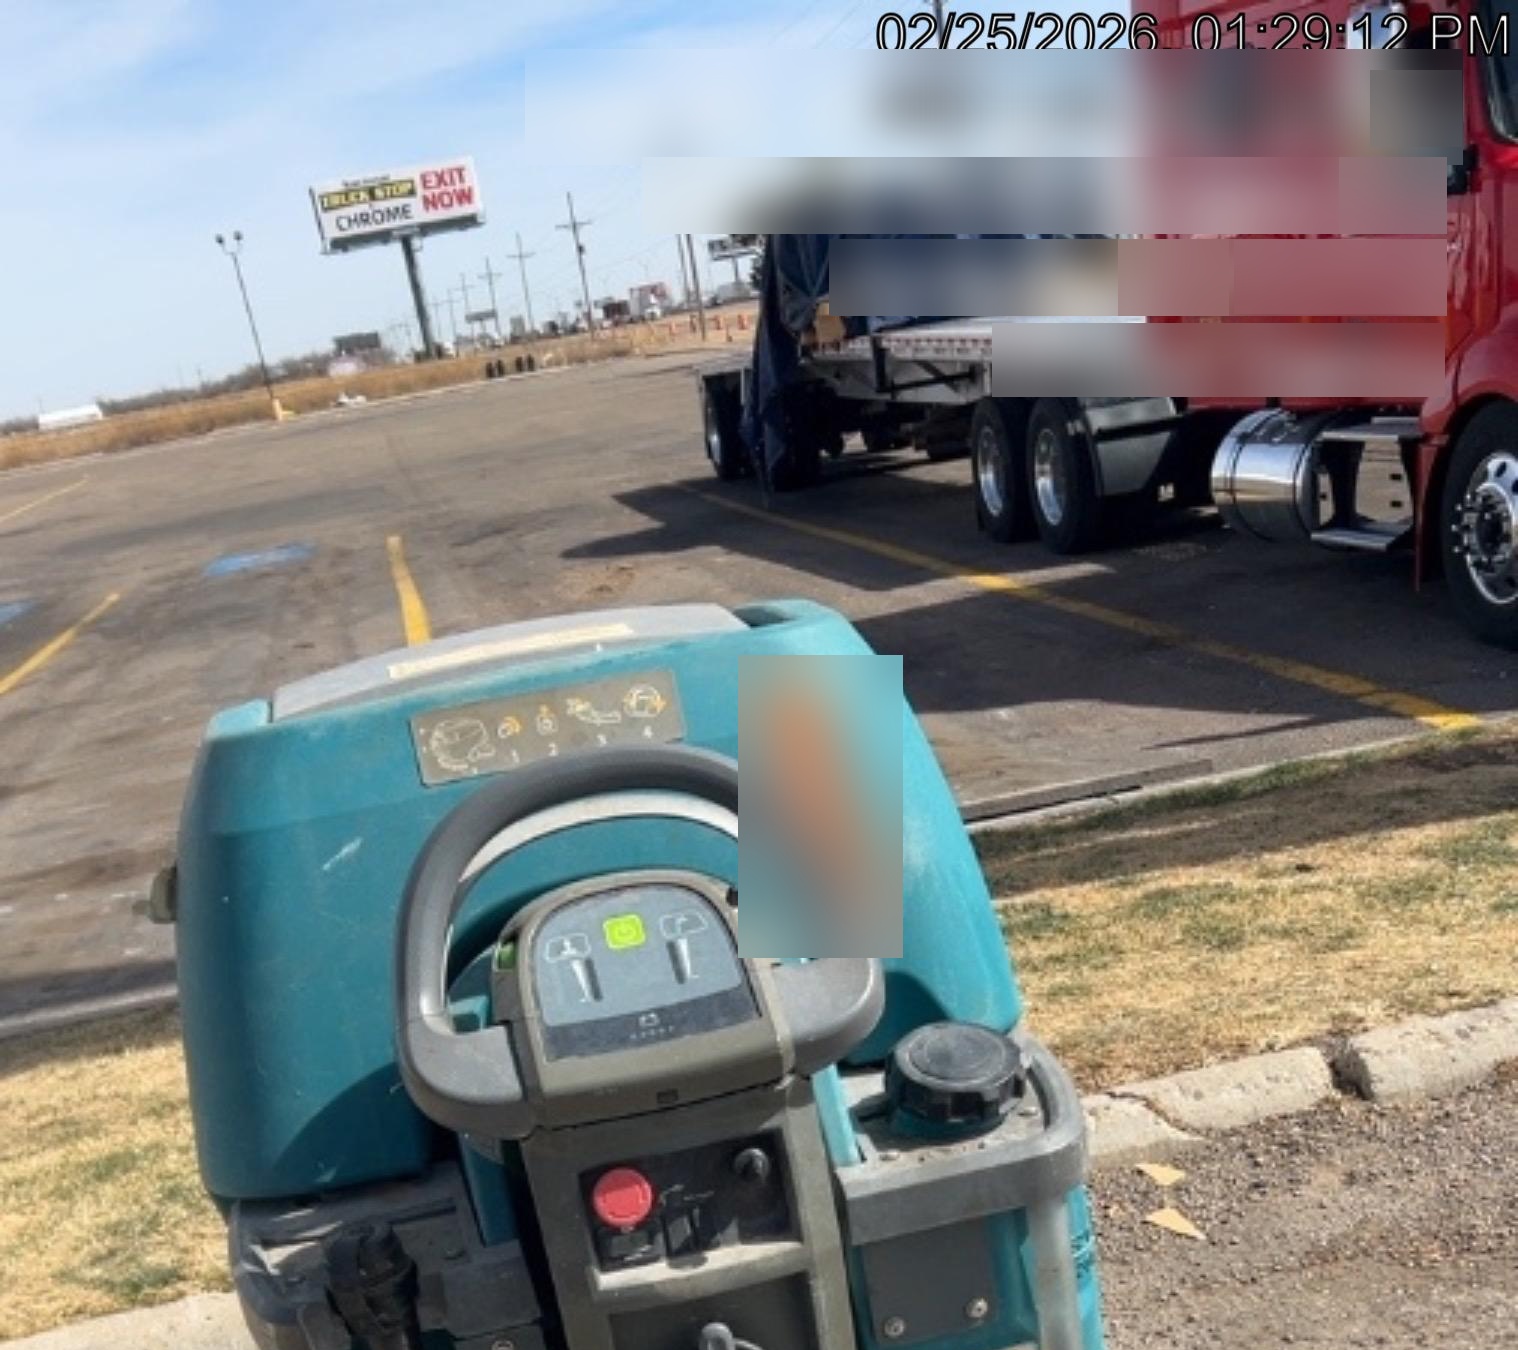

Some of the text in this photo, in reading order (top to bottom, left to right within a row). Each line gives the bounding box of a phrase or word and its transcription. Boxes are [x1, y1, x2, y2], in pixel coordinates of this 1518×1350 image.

[421, 166, 466, 190] EXIT
[422, 187, 474, 211] NOW
[336, 203, 414, 231] CHROME
